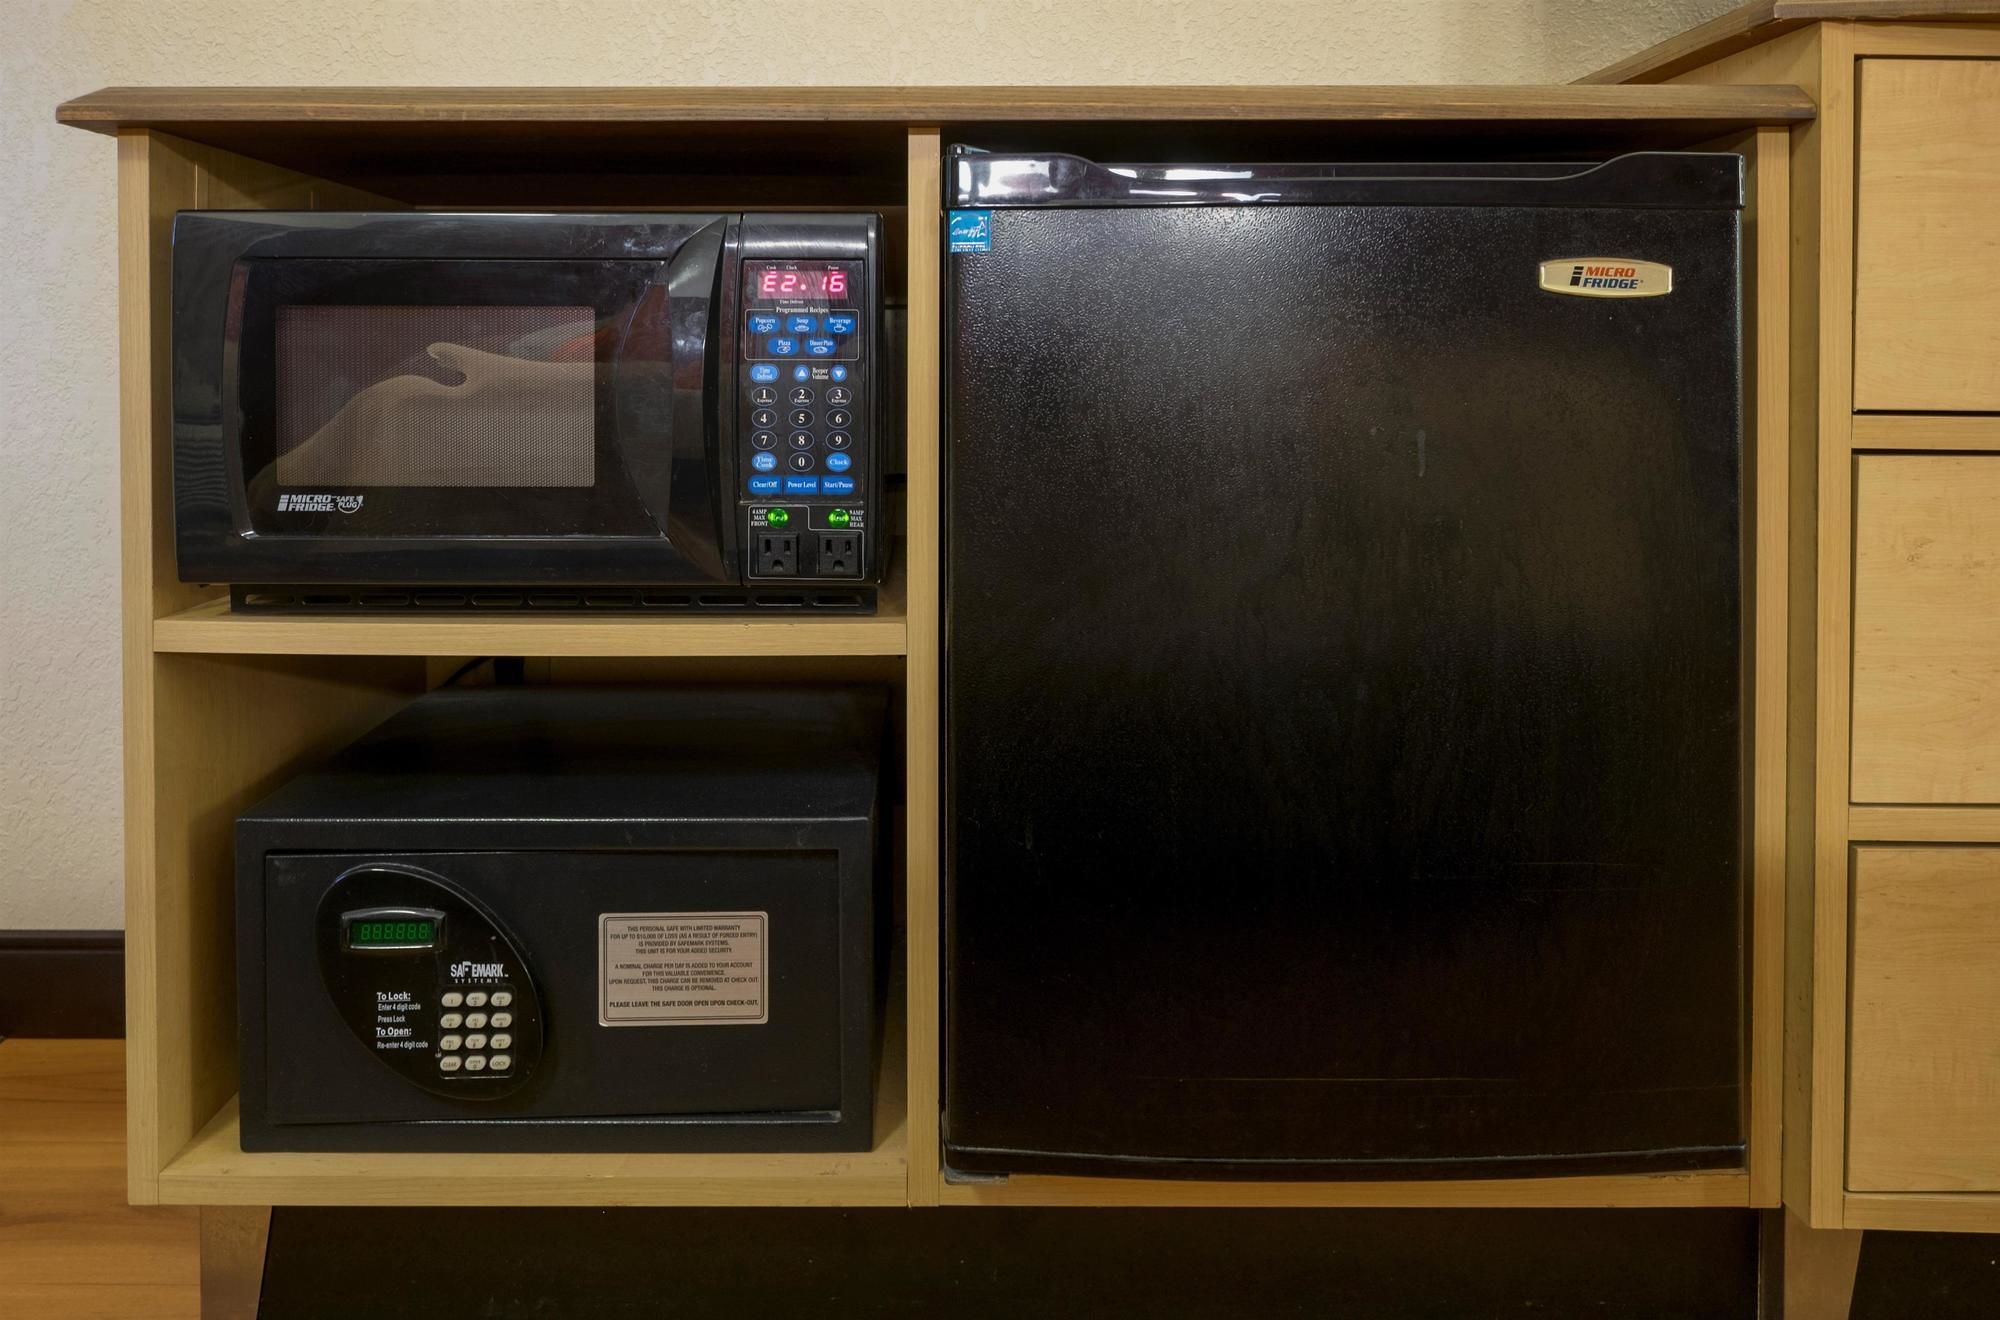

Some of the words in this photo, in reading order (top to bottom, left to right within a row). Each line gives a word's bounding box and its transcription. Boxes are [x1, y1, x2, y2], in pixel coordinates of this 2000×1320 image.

[1586, 266, 1636, 277] MICRO
[1582, 278, 1639, 289] FRIDGE
[762, 389, 766, 398] 1
[799, 389, 805, 398] 2
[835, 389, 842, 399] 3
[760, 413, 767, 423] 4
[798, 414, 805, 423] 5
[835, 413, 842, 423] 6
[761, 435, 767, 445] 7
[798, 435, 805, 445] 8
[835, 435, 842, 445] 9
[798, 457, 805, 467] 0
[290, 494, 332, 503] MICRO
[288, 503, 334, 511] FRIDGE
[450, 961, 504, 978] SAFEMARK
[377, 992, 386, 1000] To
[388, 992, 411, 1000] Lock:
[397, 1003, 408, 1012] digit
[377, 1027, 386, 1035] To
[387, 1027, 412, 1037] Open:
[404, 1041, 415, 1050] digit
